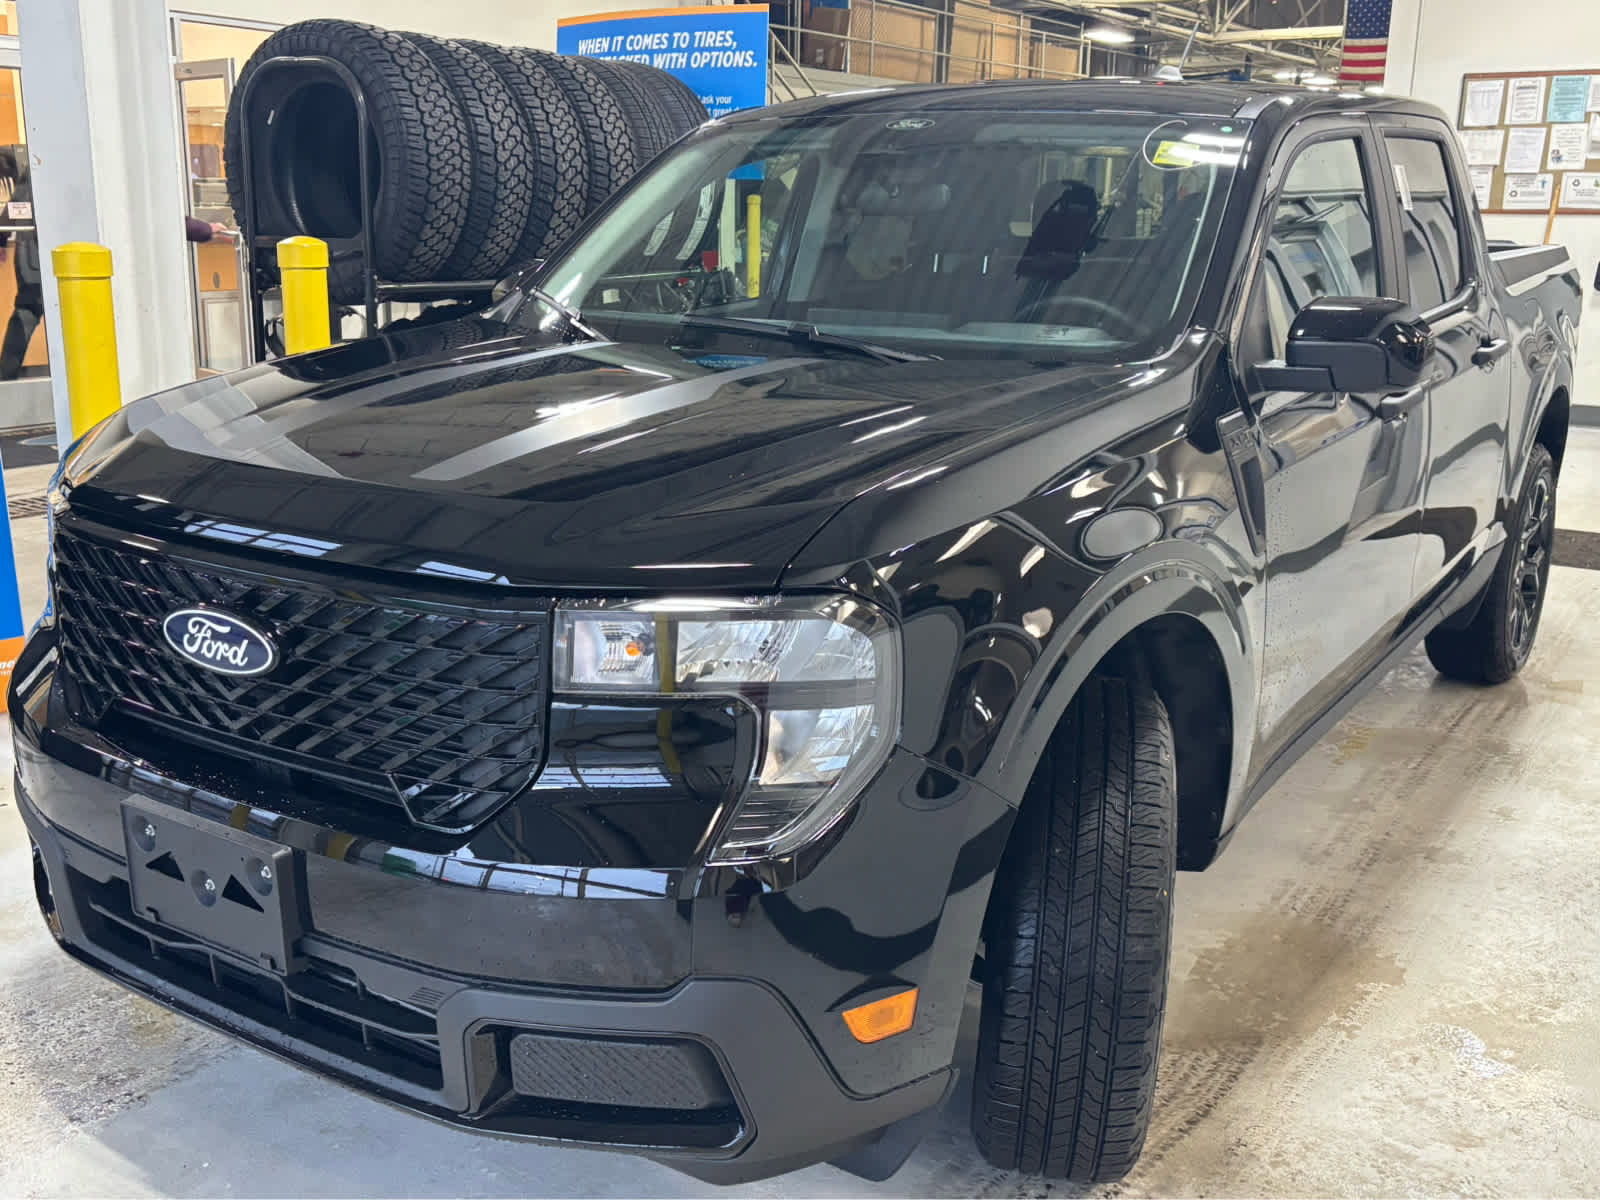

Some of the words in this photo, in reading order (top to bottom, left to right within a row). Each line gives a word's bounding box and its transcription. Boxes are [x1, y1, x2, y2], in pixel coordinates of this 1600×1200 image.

[578, 36, 610, 56] WHEN
[611, 35, 625, 52] IT
[626, 32, 669, 51] COMES
[672, 31, 690, 48] TO
[693, 30, 737, 50] TIRES,
[653, 52, 688, 69] WITH
[690, 50, 758, 68] OPTIONS.
[701, 94, 714, 105] ask
[715, 95, 732, 106] your
[183, 616, 249, 667] Ford
